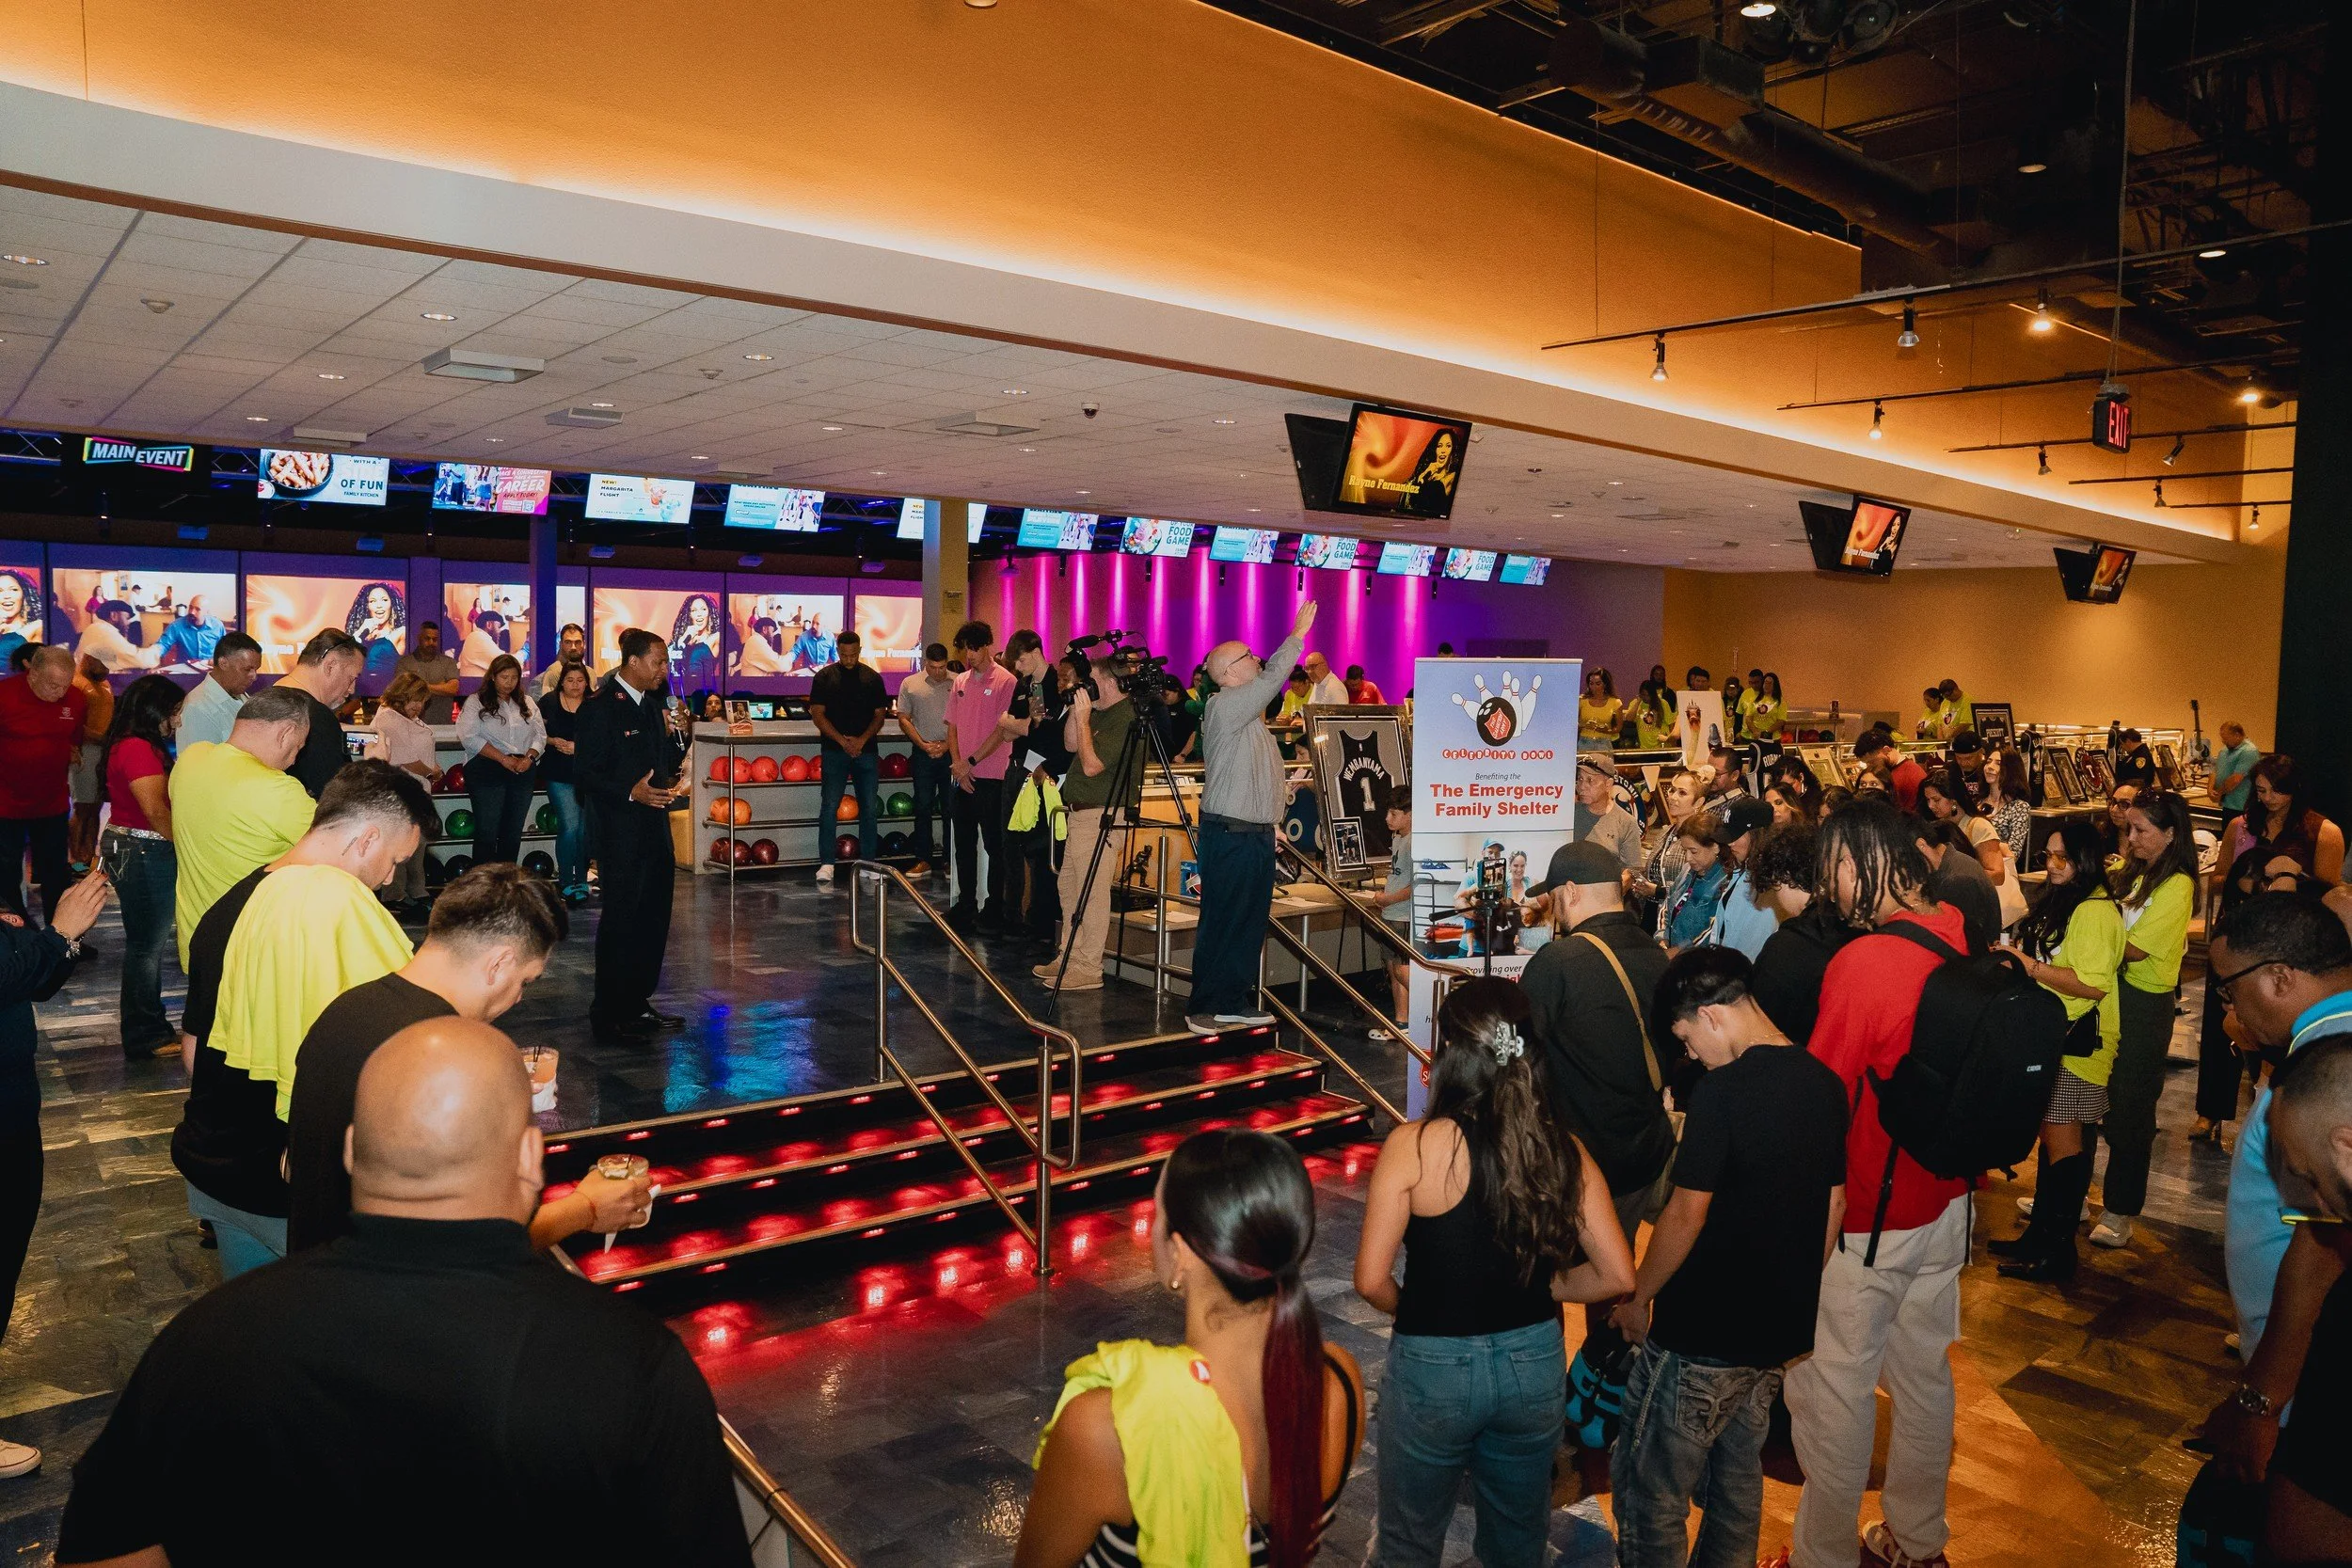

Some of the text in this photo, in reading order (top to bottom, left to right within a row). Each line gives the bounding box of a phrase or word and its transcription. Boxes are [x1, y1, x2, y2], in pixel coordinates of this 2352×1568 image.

[2108, 401, 2129, 449] EXIT
[92, 442, 187, 466] MAIN EVENT
[341, 479, 384, 490] OF FUN
[495, 479, 546, 494] CAREER
[1348, 474, 1421, 494] Rayne Fernandez
[1168, 526, 1192, 536] FOOD
[1166, 535, 1190, 546] GAME
[1336, 541, 1357, 551] FOOD
[1334, 550, 1355, 560] GAME
[1478, 555, 1495, 564] FOOD
[1475, 563, 1493, 572] GAME
[1442, 748, 1554, 761] CELEBRITY BOWL
[1343, 756, 1385, 782] WEMBANYAMA
[1475, 772, 1521, 782] Benefiting the
[1359, 776, 1376, 812] 1
[1429, 783, 1564, 800] The Emergency
[1436, 801, 1559, 818] Family Shelter
